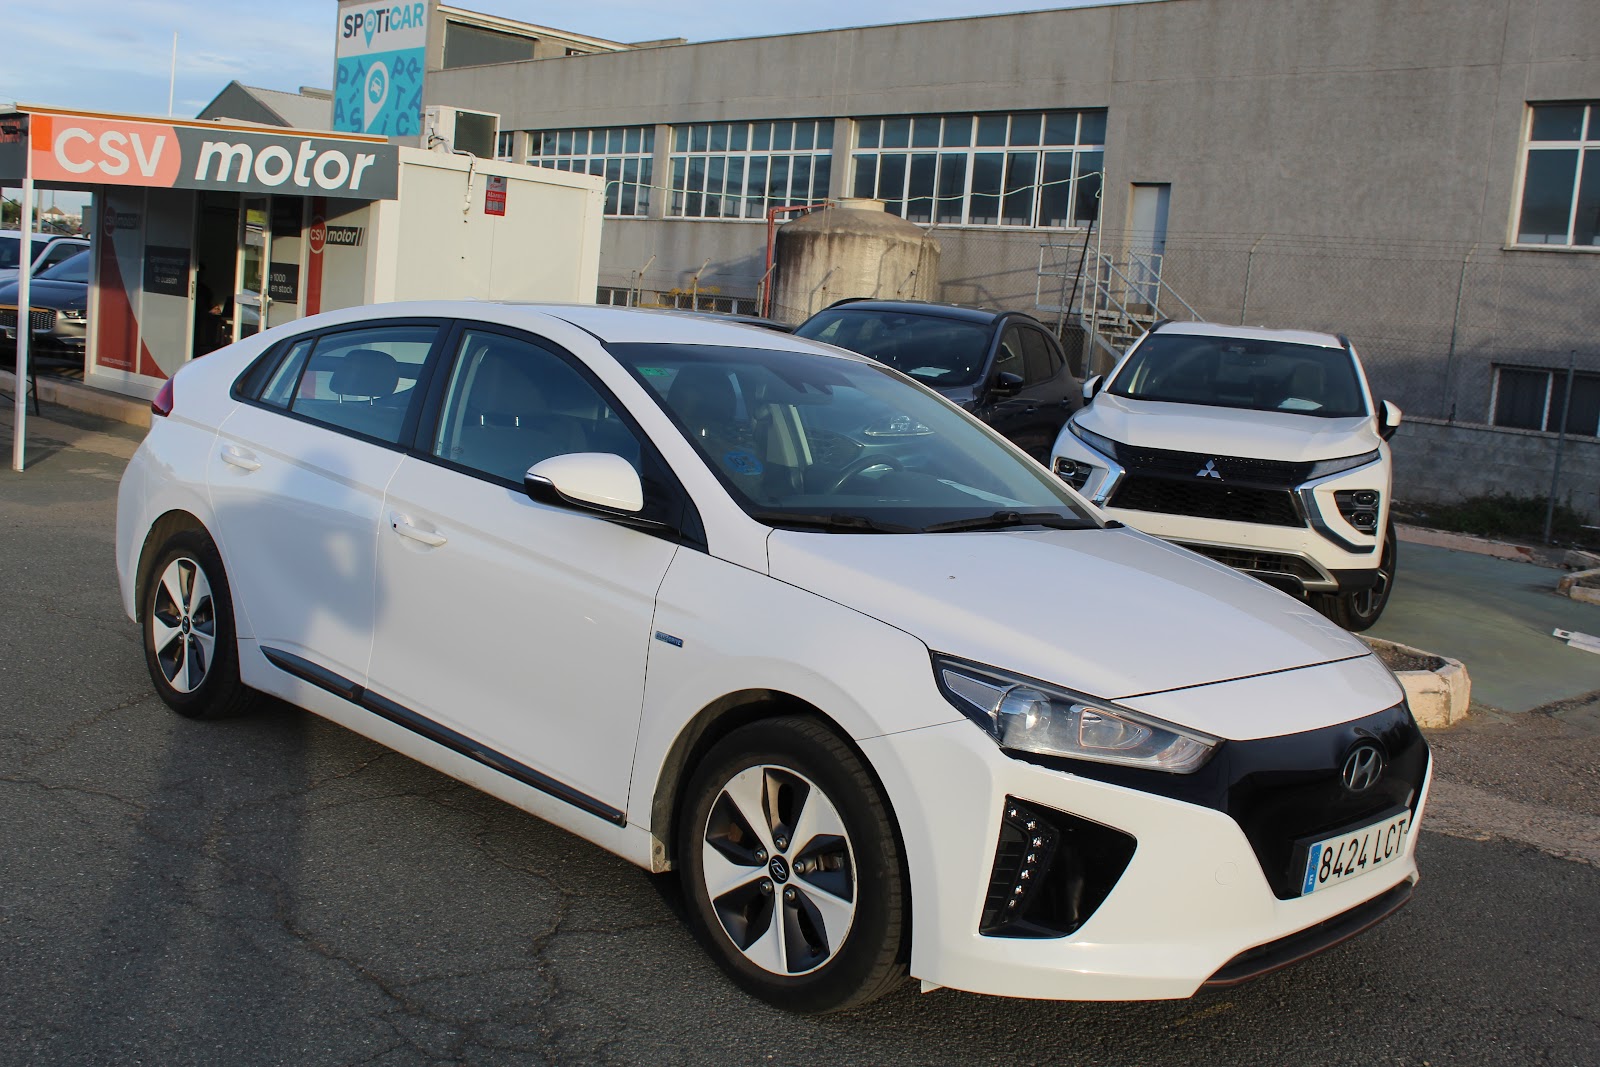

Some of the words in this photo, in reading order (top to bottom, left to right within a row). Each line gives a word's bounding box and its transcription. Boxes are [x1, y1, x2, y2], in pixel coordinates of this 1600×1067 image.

[54, 127, 166, 177] CSV
[194, 140, 376, 190] motor
[310, 228, 325, 241] CSV
[327, 228, 356, 243] motor
[273, 273, 287, 283] 1000
[279, 285, 293, 294] stock
[1318, 833, 1369, 883] 8424
[1373, 818, 1407, 865] LCT
[1308, 874, 1314, 885] E
